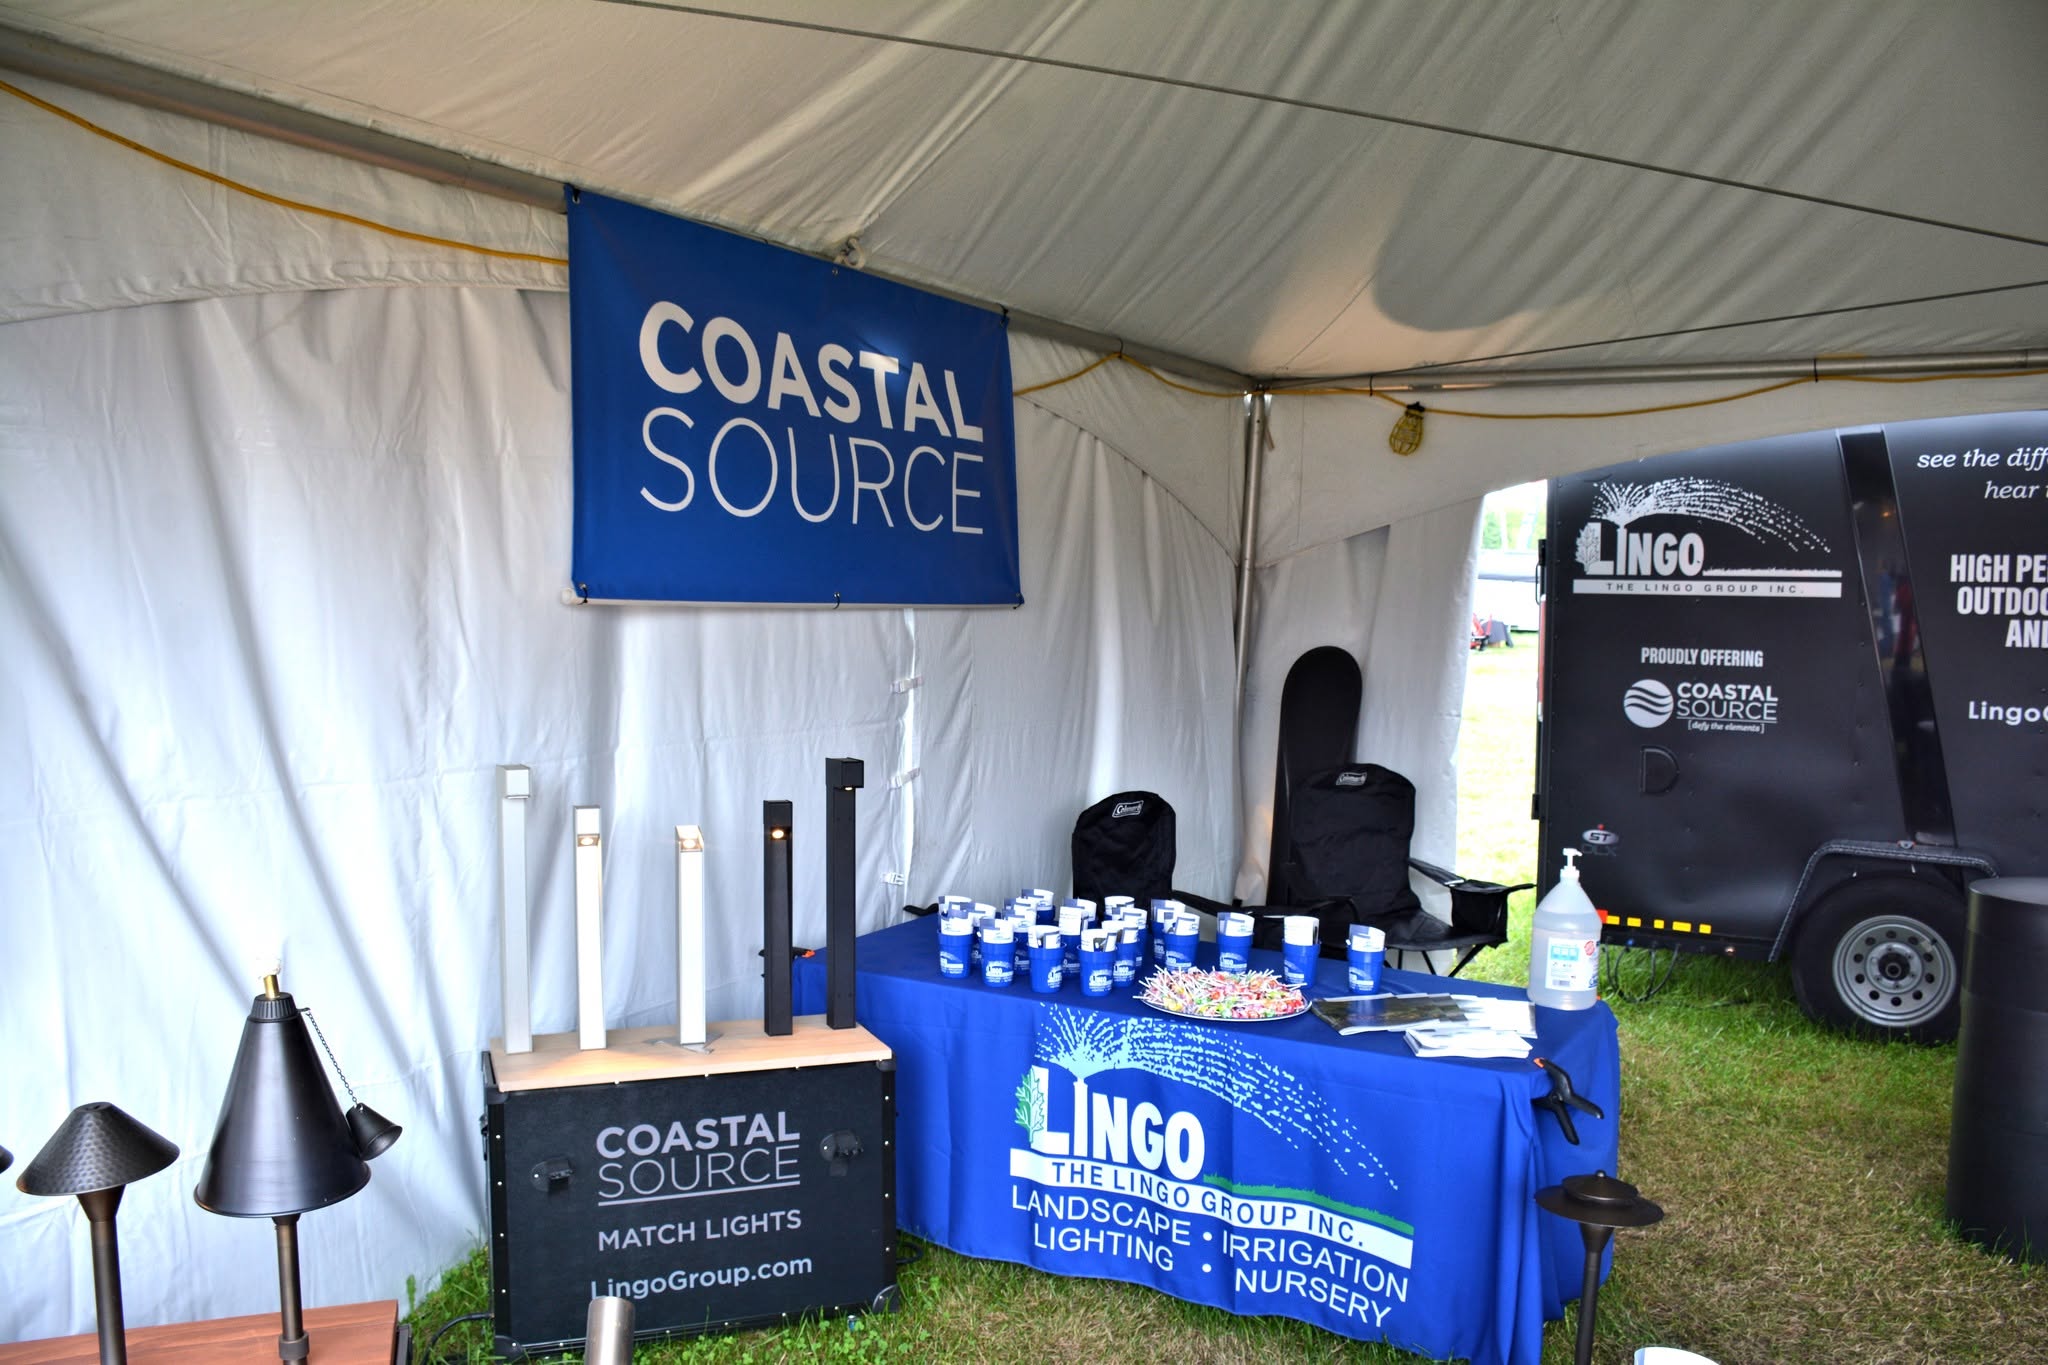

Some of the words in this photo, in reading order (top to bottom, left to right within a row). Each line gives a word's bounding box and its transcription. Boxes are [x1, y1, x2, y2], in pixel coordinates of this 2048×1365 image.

[639, 300, 984, 443] COASTAL
[640, 407, 984, 535] SOURCE
[1917, 453, 1957, 468] see
[1963, 448, 2000, 467] the
[2007, 447, 2048, 471] diff
[1984, 480, 2040, 499] hear
[1576, 522, 1705, 576] LINGO
[1950, 554, 2010, 583] HIGH
[2016, 554, 2048, 583] PE
[1606, 583, 1634, 591] THE
[1645, 583, 1693, 592] LINGO
[1704, 584, 1759, 593] GROUP
[1769, 585, 1805, 593] INC.
[1641, 647, 1698, 665] PROUDLY
[1701, 649, 1764, 667] OFFERING
[1677, 682, 1778, 702] COASTAL
[1677, 699, 1778, 721] SOURCE
[1969, 701, 2048, 726] Lingo
[1711, 722, 1724, 730] the
[596, 1111, 801, 1159] COASTAL
[1020, 1065, 1206, 1181] LINGO
[598, 1144, 801, 1199] SOURCE
[1052, 1161, 1103, 1188] THE
[1113, 1170, 1190, 1208] LINGO
[1201, 1193, 1297, 1227] GROUP
[1308, 1209, 1363, 1247] INC.
[598, 1221, 696, 1252] MATCH
[705, 1209, 802, 1240] LIGHTS
[1012, 1185, 1191, 1246] LANDSCAPE
[1223, 1230, 1409, 1303] IRRIGATION
[591, 1257, 812, 1300] LingoGroup.com
[1034, 1225, 1174, 1272] LIGHTING
[1235, 1267, 1391, 1328] NURSERY
